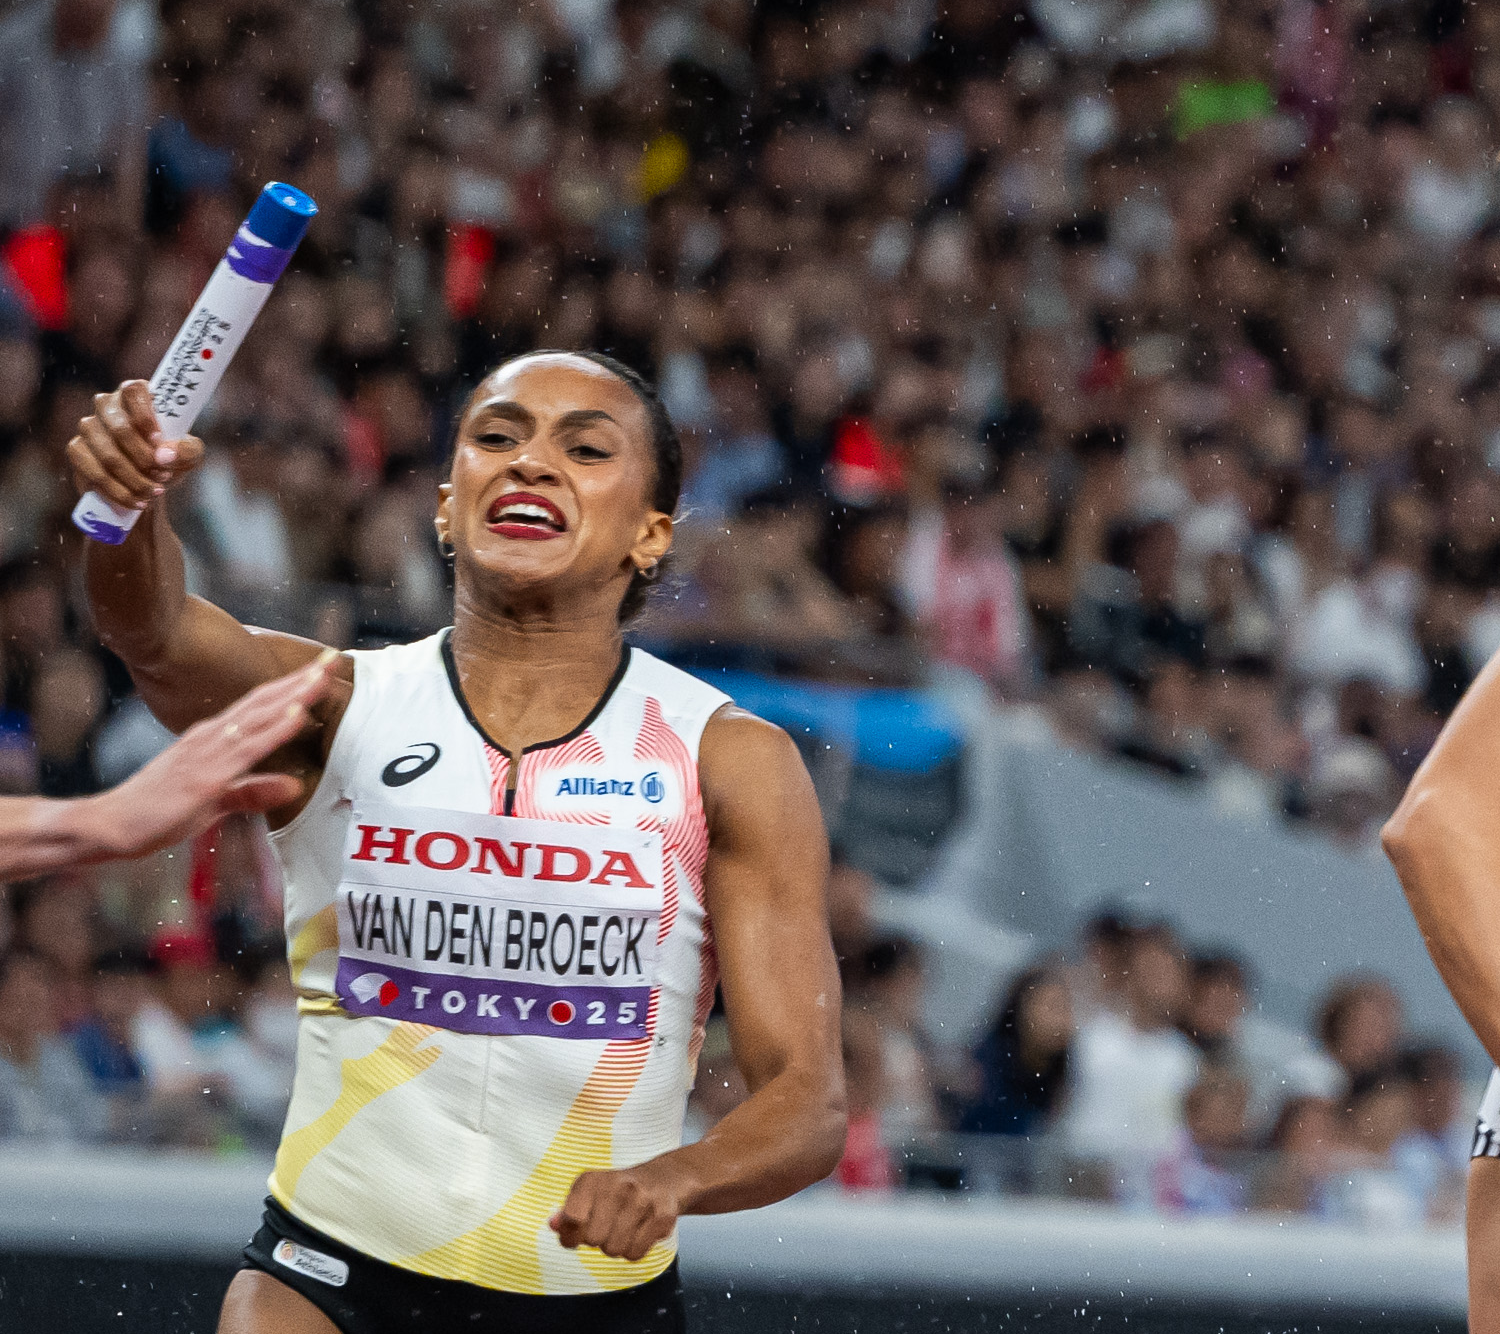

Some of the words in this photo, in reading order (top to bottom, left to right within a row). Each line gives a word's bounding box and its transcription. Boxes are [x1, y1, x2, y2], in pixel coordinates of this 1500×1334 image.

[556, 777, 636, 797] Allianz
[351, 825, 655, 889] HONDA
[349, 891, 415, 959] VAN
[423, 900, 495, 968] DEN
[503, 909, 649, 977] BROECK
[585, 1001, 638, 1025] 25
